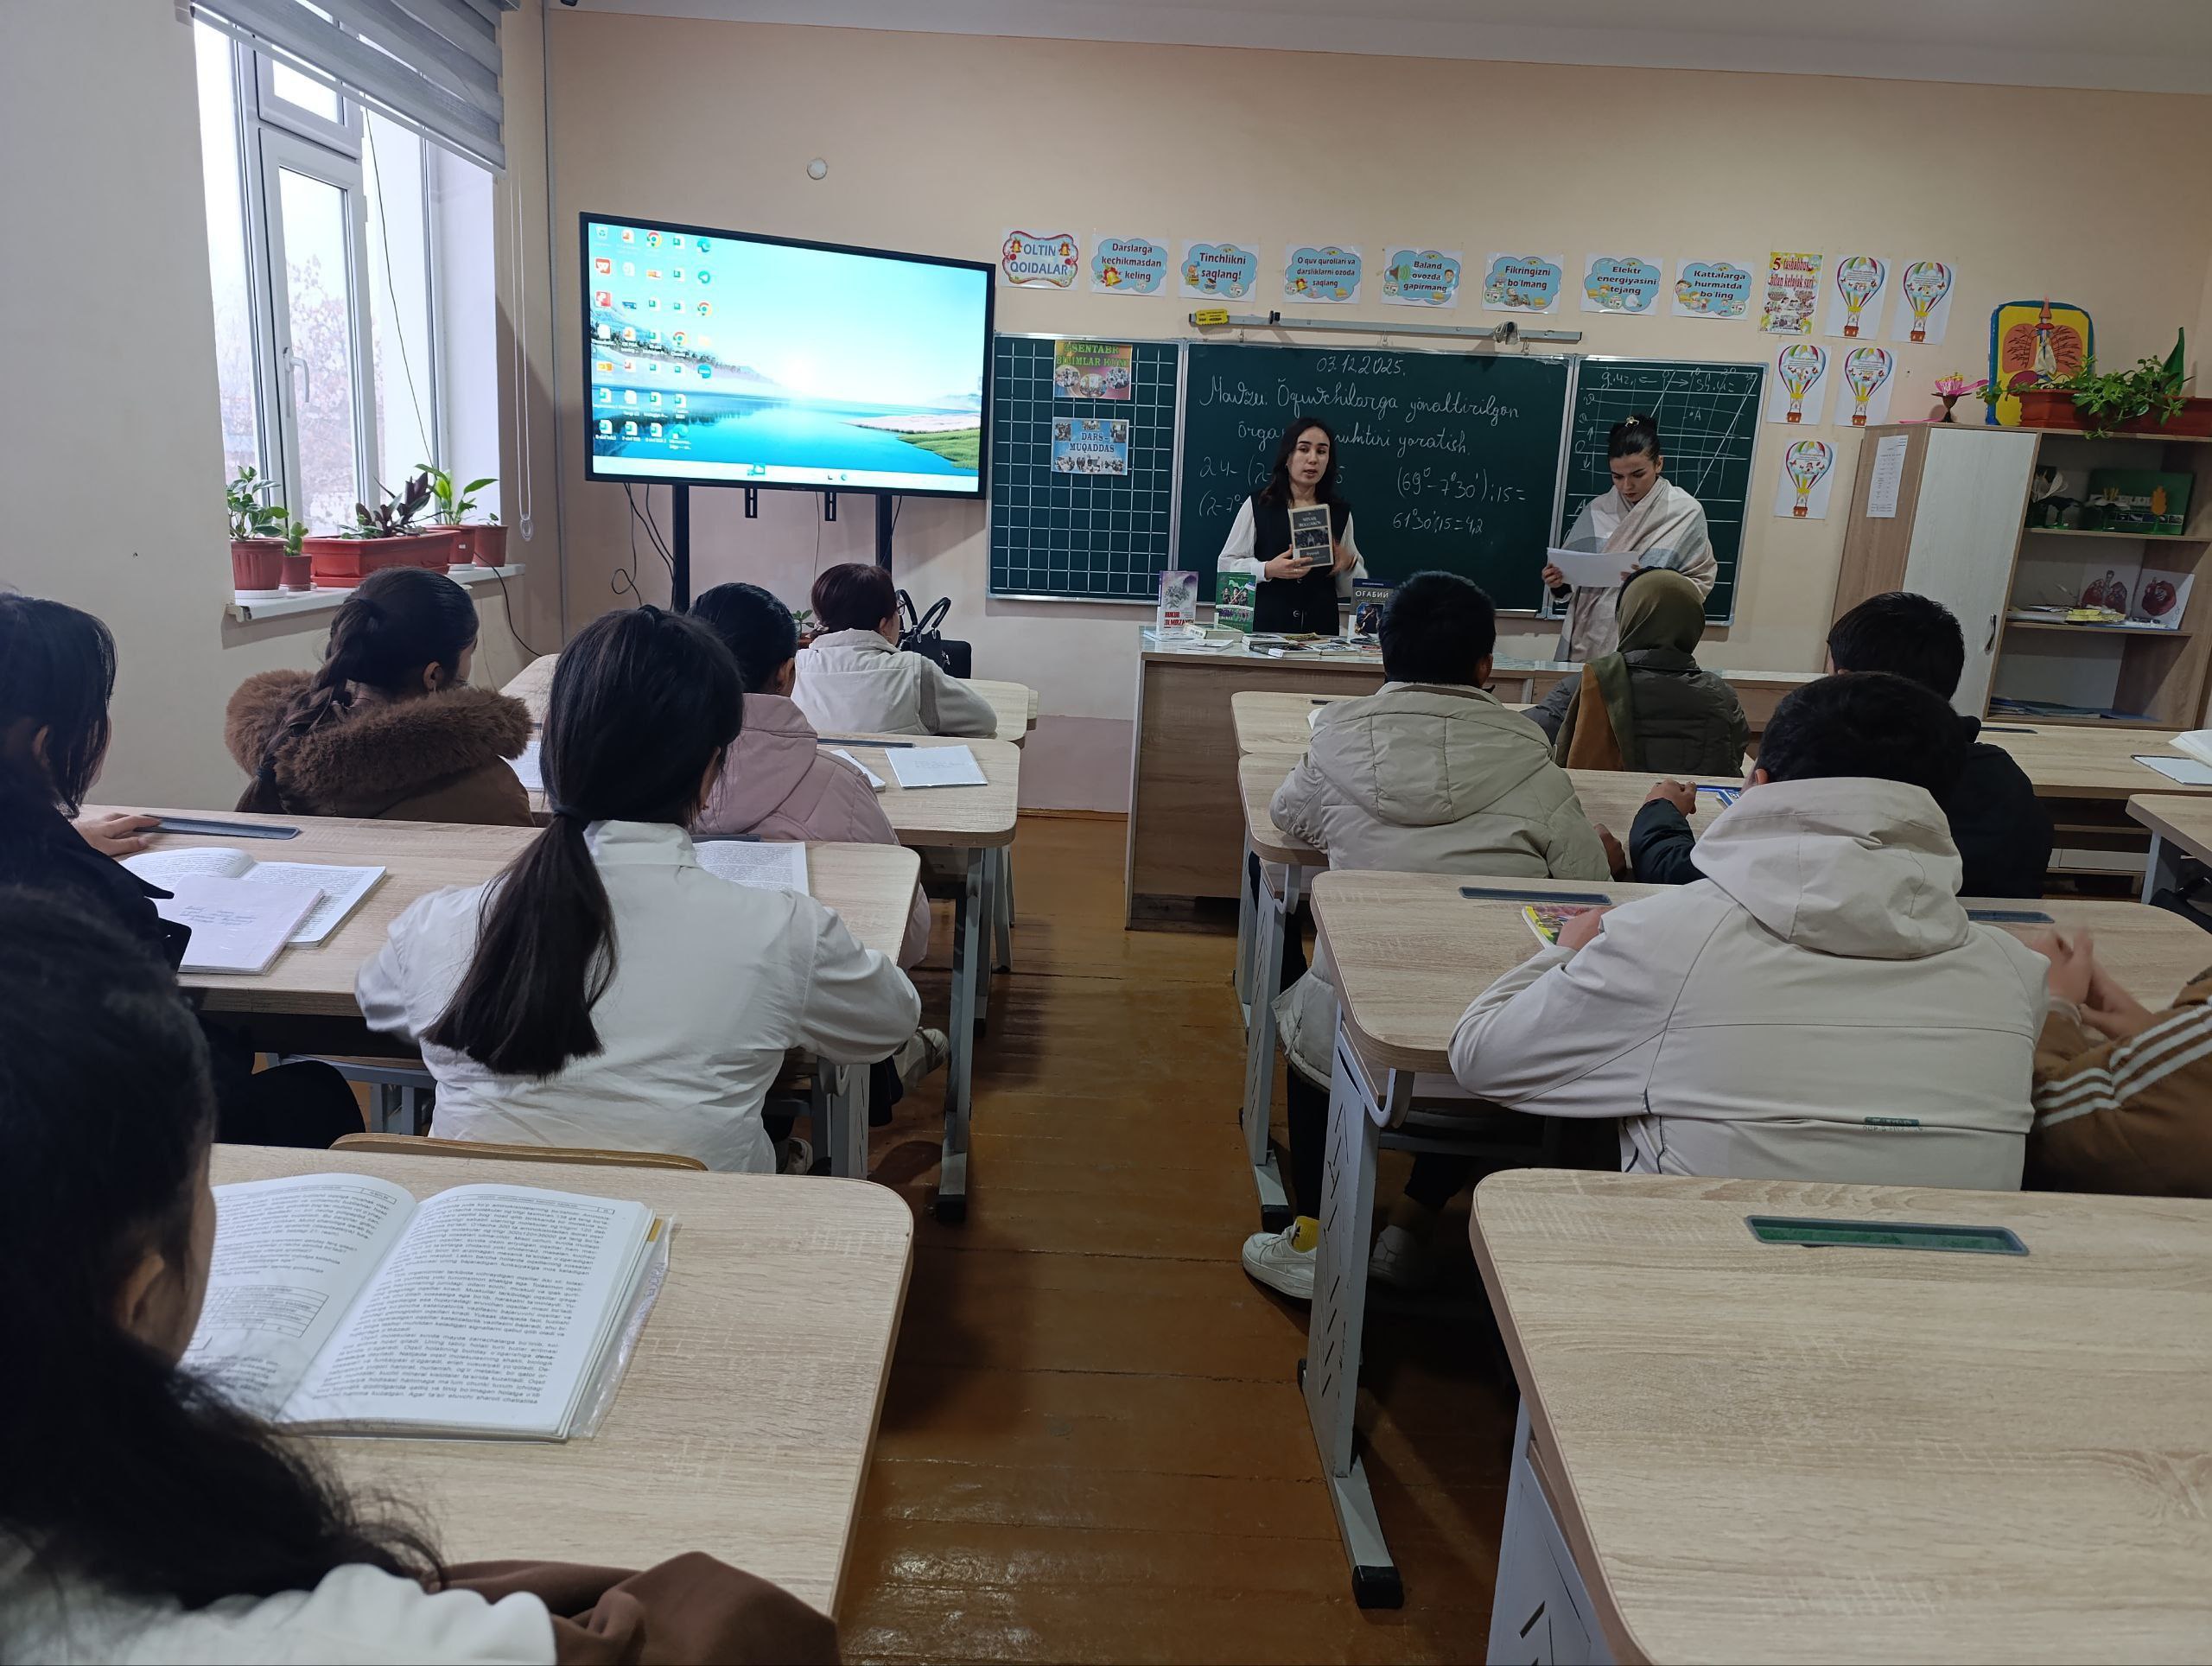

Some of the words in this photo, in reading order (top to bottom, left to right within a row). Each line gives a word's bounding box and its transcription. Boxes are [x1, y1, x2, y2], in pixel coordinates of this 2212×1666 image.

[1023, 244, 1057, 257] OLTIN
[1112, 243, 1153, 256] Darslarga
[1102, 256, 1161, 268] kechikmasdan
[1199, 252, 1246, 265] Tinchlikni
[1318, 258, 1346, 266] qurollari
[1772, 257, 1782, 270] 5
[1010, 261, 1068, 276] QOIDALAR
[1414, 260, 1442, 270] Baland
[1612, 266, 1642, 275] Elektr
[1125, 270, 1151, 283] keling
[1201, 269, 1242, 283] saqlang!
[1412, 272, 1441, 281] ovozda
[1505, 265, 1551, 277] Fikringizni
[1694, 270, 1745, 281] Kattalarga
[1313, 280, 1338, 289] saqlang
[1597, 276, 1657, 285] energiyasini
[1694, 280, 1742, 289] hurmatda
[1403, 283, 1447, 293] gapirmang
[1610, 286, 1642, 296] tejang
[1069, 442, 1115, 454] MUQADDAS
